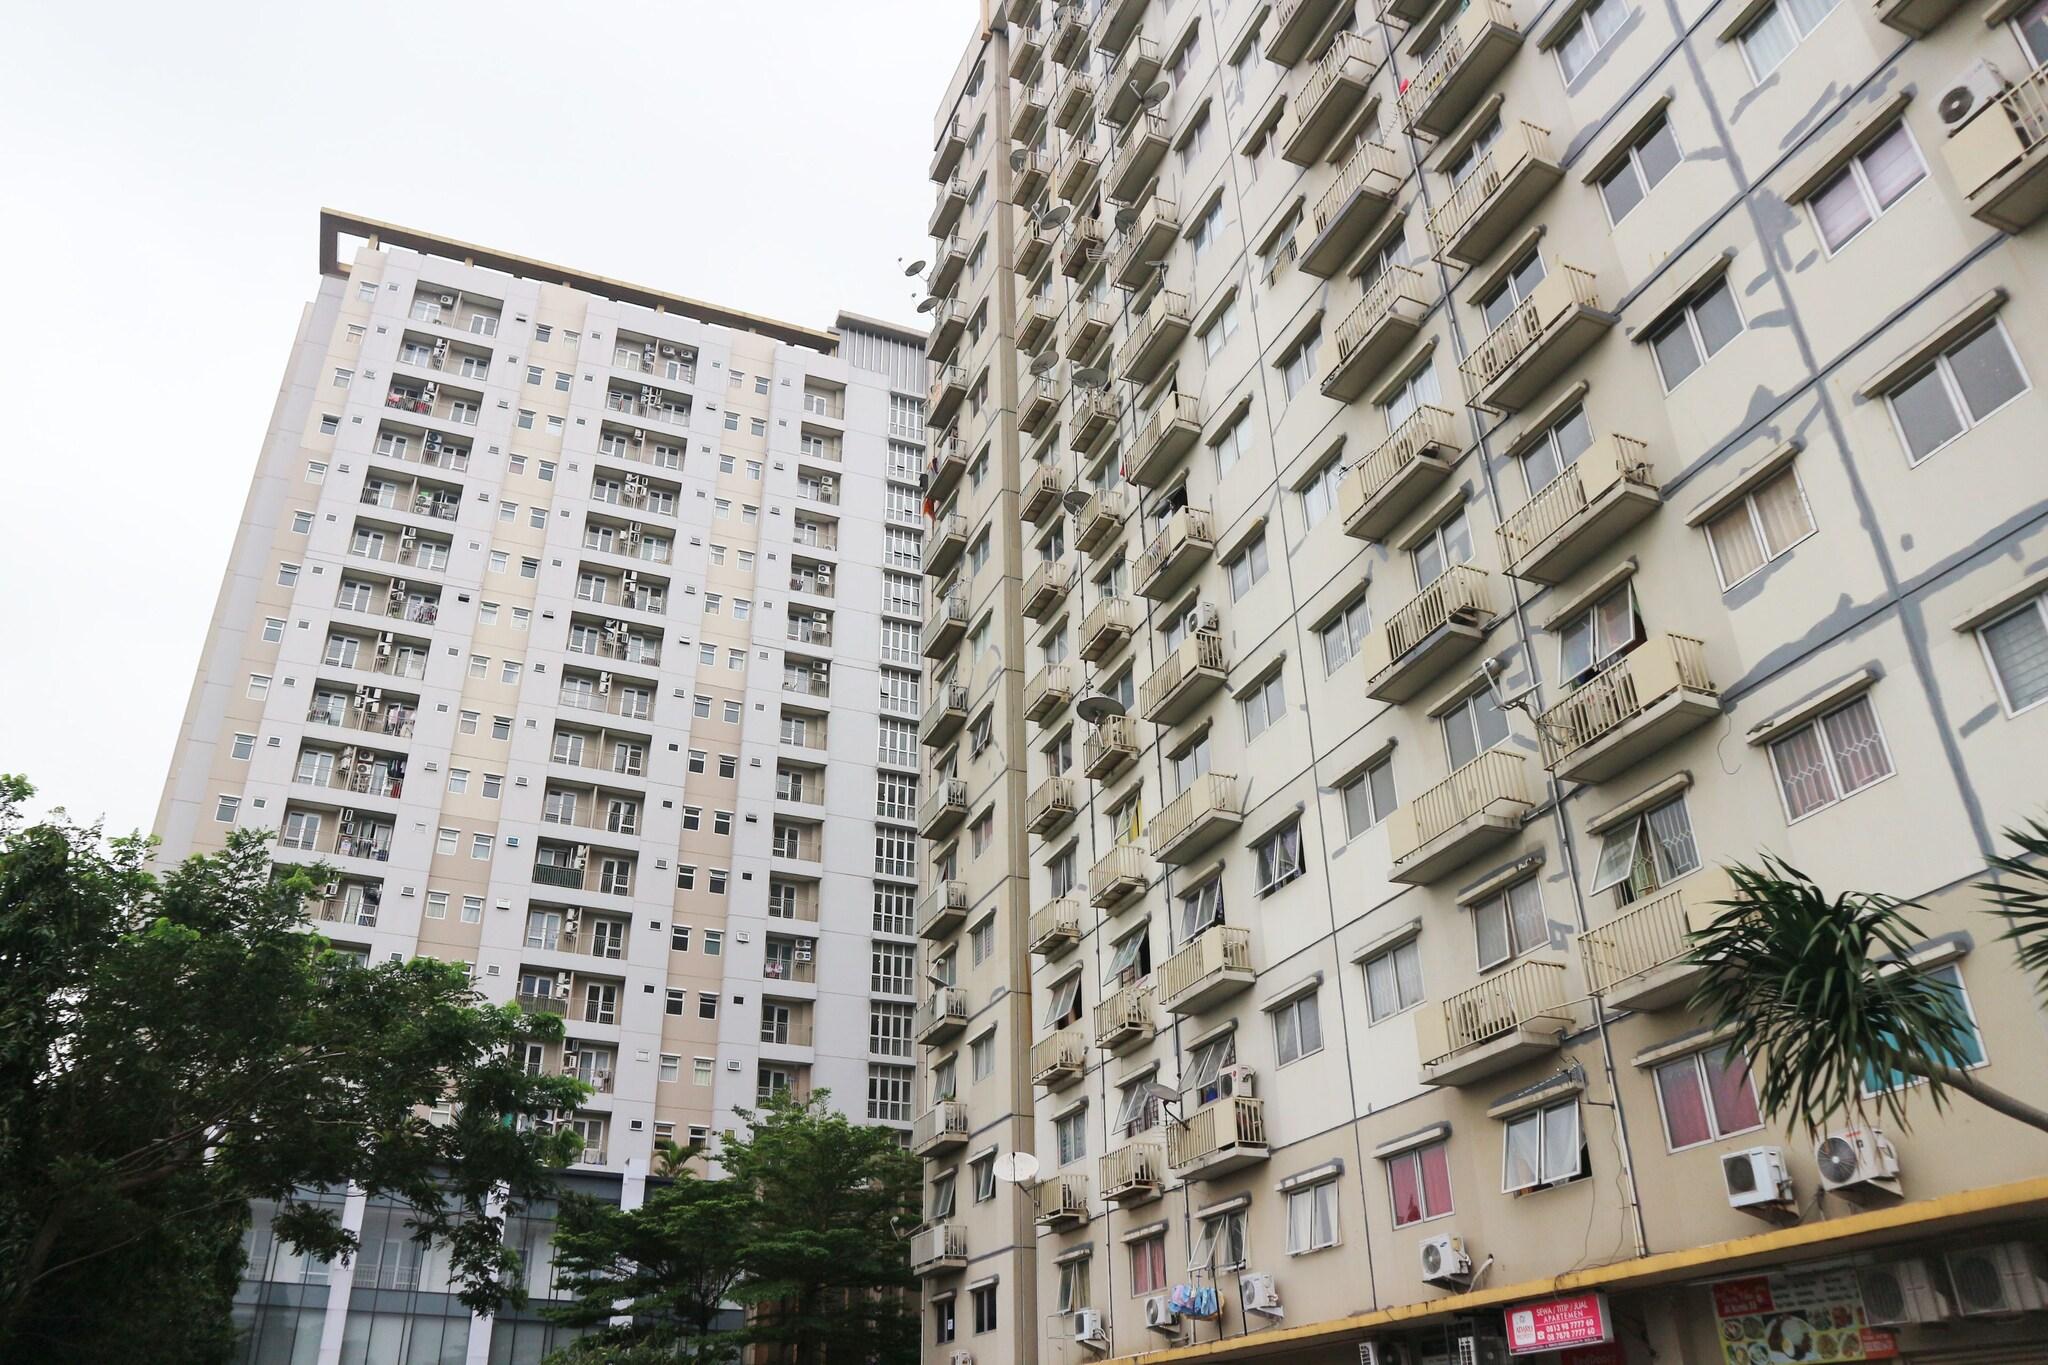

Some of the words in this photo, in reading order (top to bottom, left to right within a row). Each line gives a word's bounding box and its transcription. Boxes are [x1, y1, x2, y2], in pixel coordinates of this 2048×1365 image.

[1536, 1307, 1552, 1317] SEWA
[1556, 1303, 1569, 1313] TITIP
[1574, 1300, 1588, 1310] JUAL
[1543, 1310, 1584, 1323] APARTEMEN
[1545, 1323, 1561, 1333] 0813
[1569, 1319, 1585, 1329] 7777
[1571, 1328, 1586, 1338] 7777
